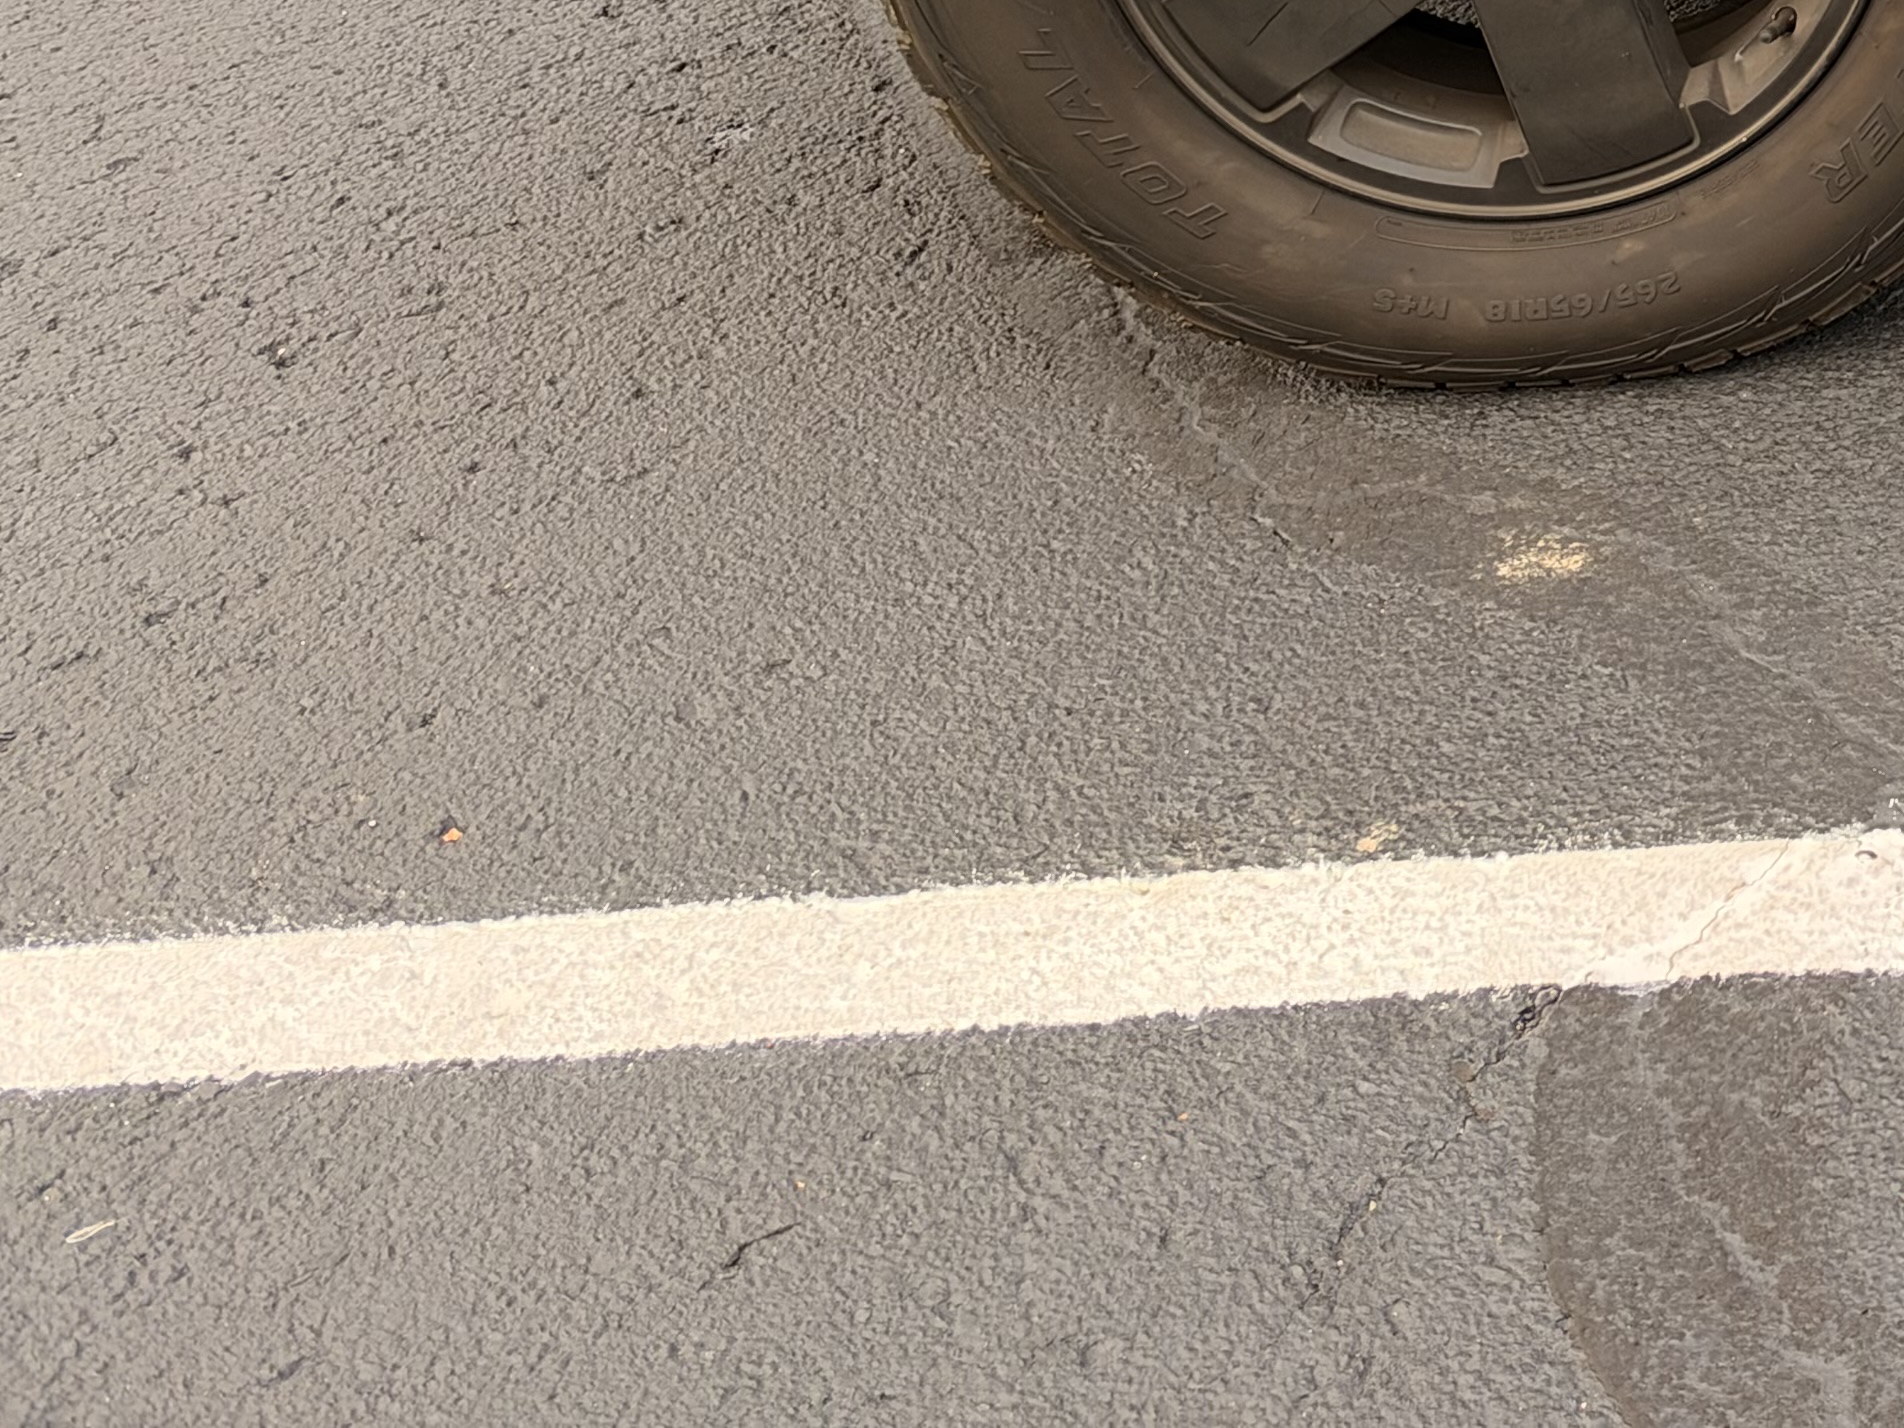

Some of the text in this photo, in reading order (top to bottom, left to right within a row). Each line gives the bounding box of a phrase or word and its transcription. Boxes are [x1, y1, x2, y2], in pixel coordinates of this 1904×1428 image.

[1019, 28, 1228, 239] TOTAL
[1372, 270, 1682, 323] 265/65R18 M+S
